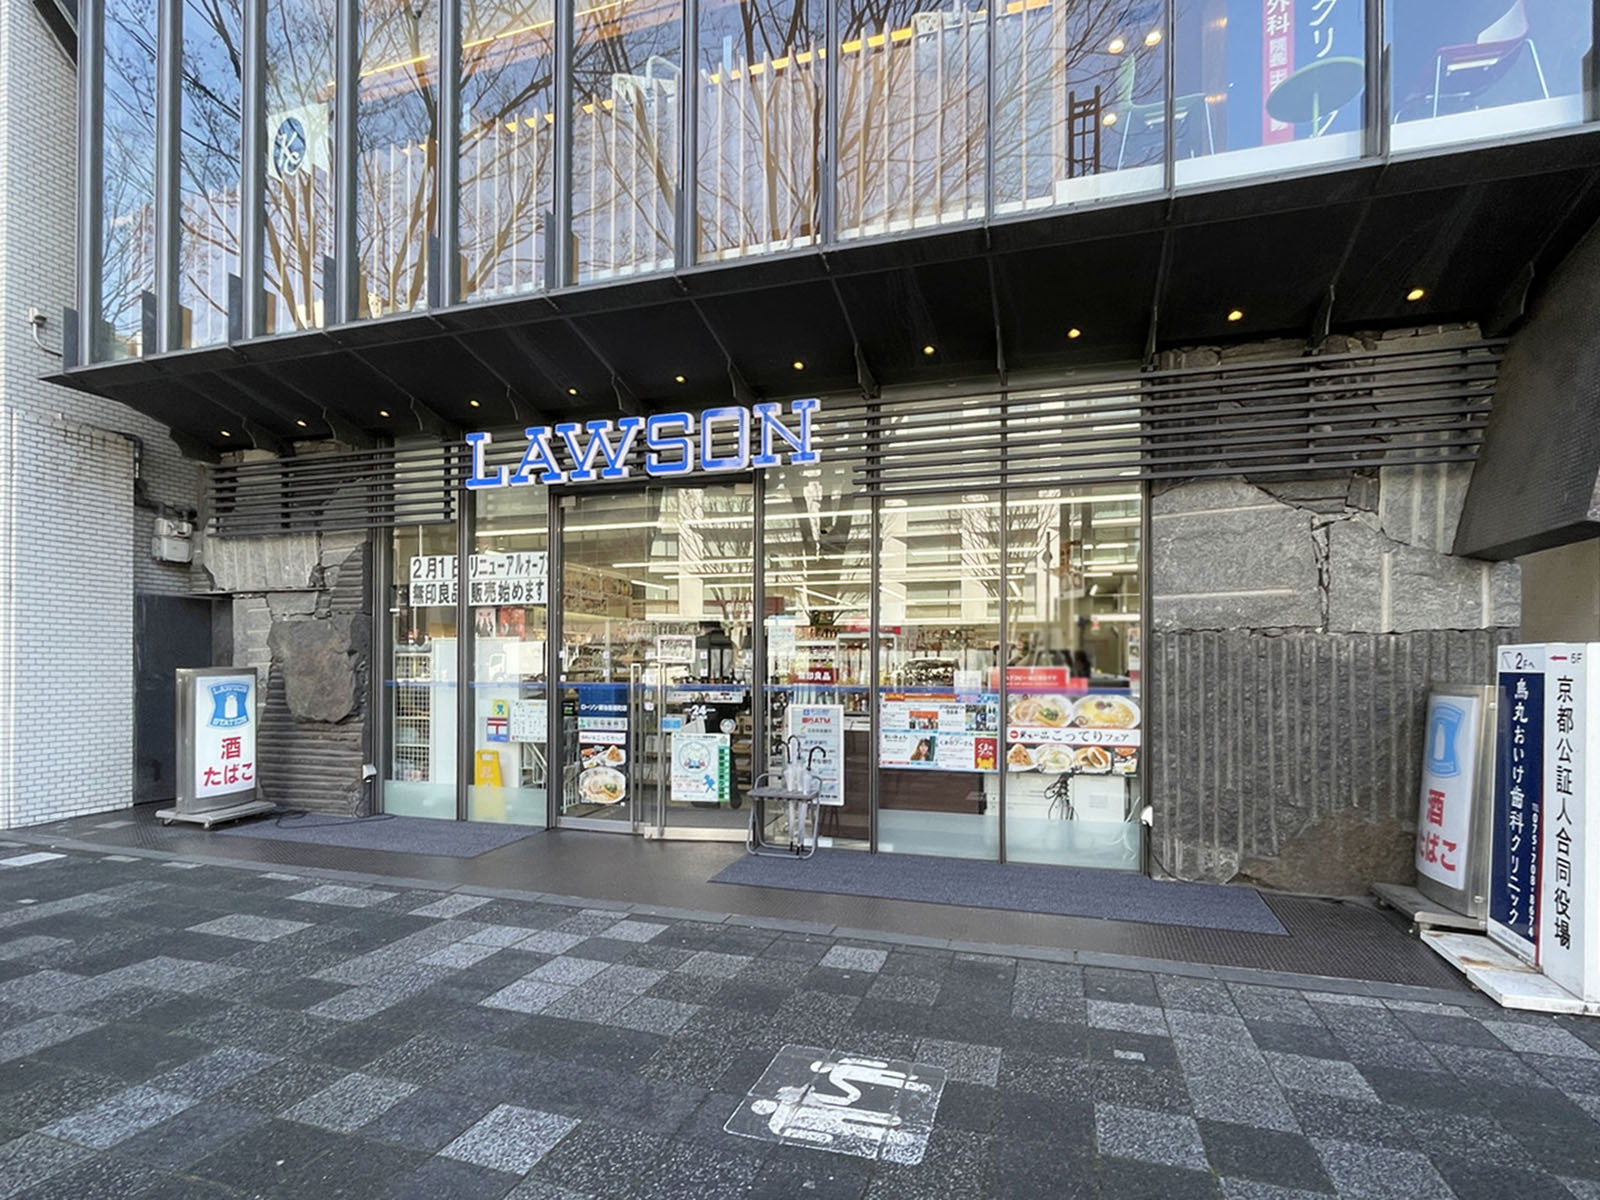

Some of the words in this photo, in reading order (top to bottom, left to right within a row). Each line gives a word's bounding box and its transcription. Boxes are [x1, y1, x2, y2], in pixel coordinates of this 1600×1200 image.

[465, 398, 822, 490] LAWSON
[471, 581, 545, 603] 販売始めます
[221, 736, 241, 760] 酒
[204, 762, 253, 787] たばこ
[1555, 675, 1575, 950] 京都公証人合同役場
